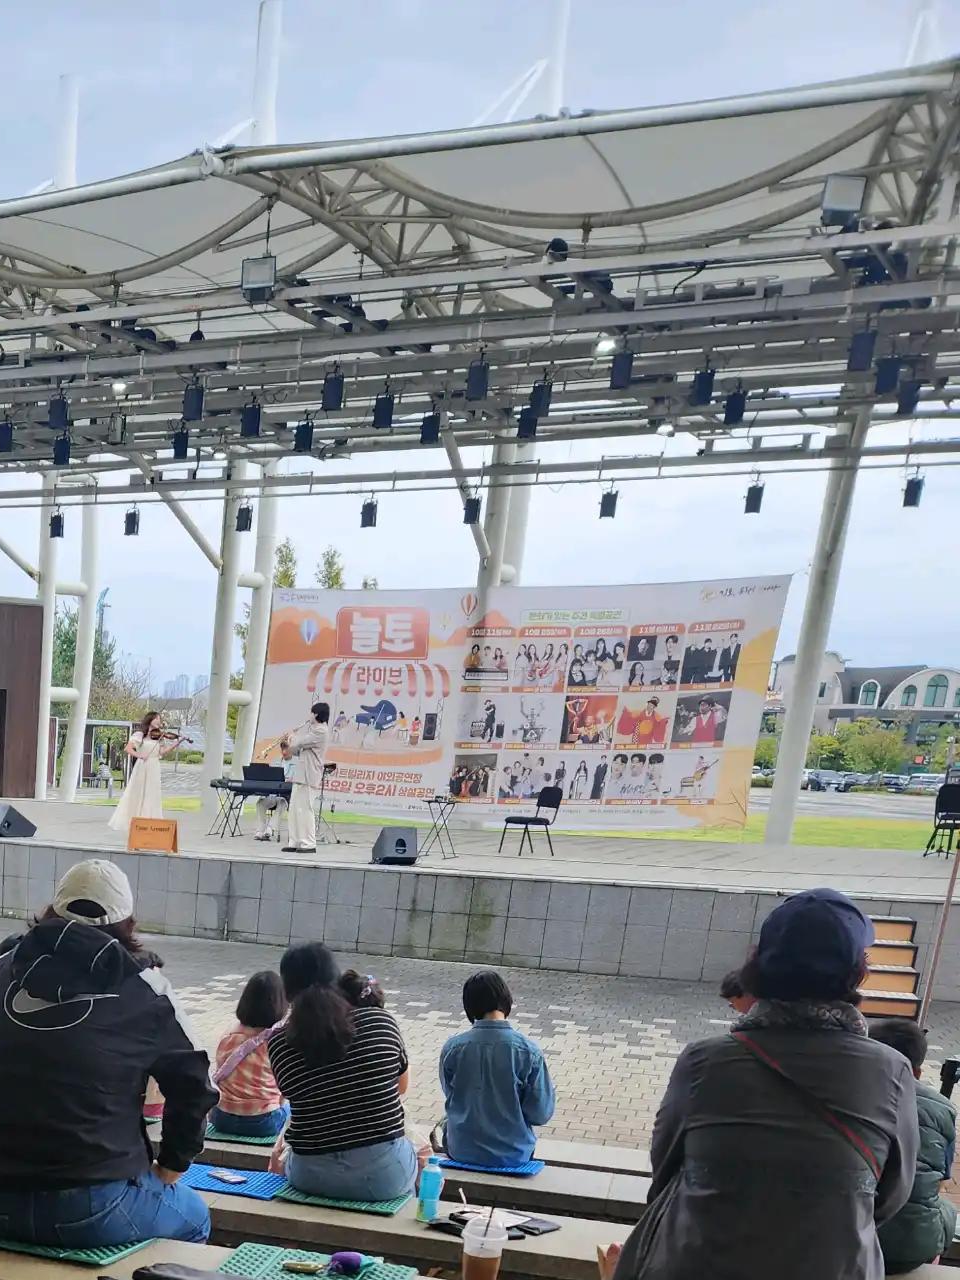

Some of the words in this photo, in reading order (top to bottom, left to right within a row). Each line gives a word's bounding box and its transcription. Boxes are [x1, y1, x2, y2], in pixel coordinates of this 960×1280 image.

[356, 666, 402, 686] 라이브
[353, 781, 397, 797] 오후2시
[398, 786, 436, 799] 상설공연
